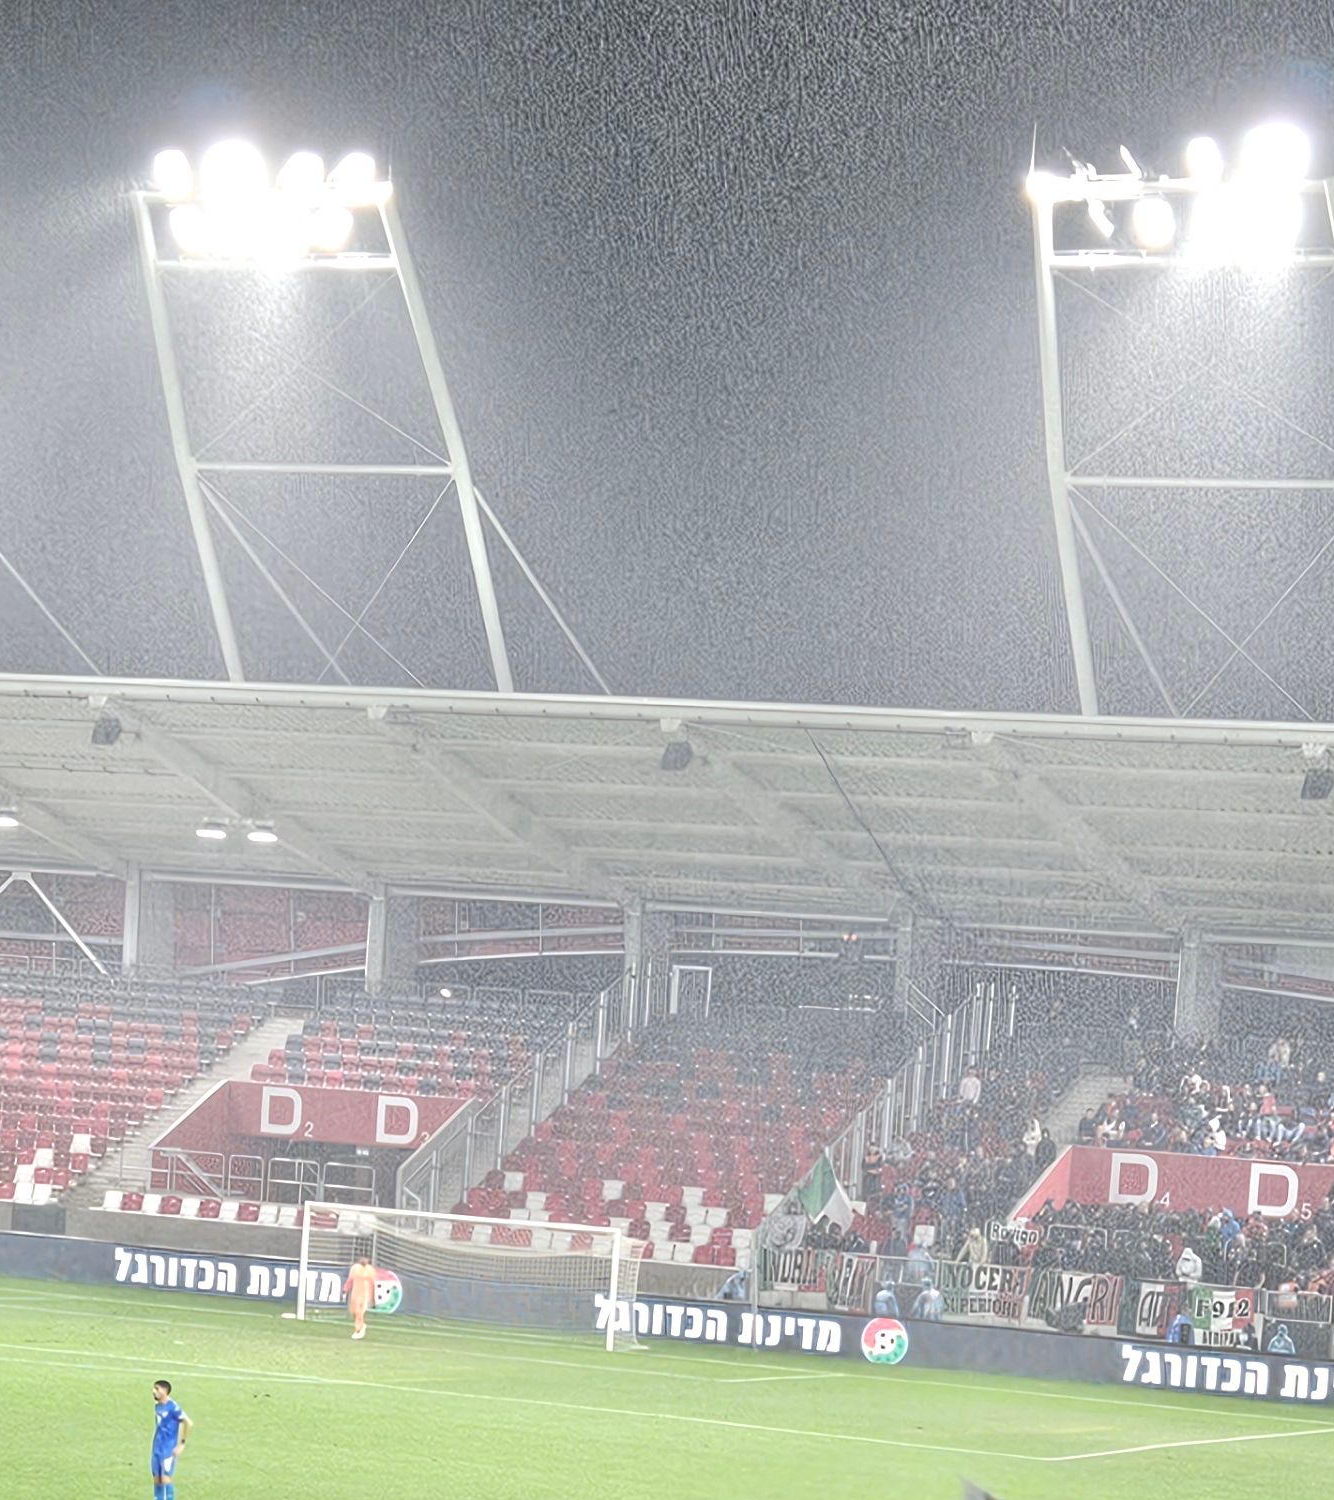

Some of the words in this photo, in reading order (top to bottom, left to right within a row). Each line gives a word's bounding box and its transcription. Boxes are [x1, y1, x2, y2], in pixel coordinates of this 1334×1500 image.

[260, 1086, 302, 1136] D
[304, 1121, 314, 1138] 2
[375, 1095, 419, 1145] D
[1108, 1153, 1158, 1204] D
[1247, 1163, 1299, 1217] D
[1300, 1202, 1312, 1221] 5
[114, 1246, 237, 1293] הכדורגל
[246, 1265, 343, 1303] מדינת
[594, 1293, 728, 1343] הכדורגל
[737, 1312, 842, 1353] מדינת
[1121, 1344, 1268, 1395] הכדורגל
